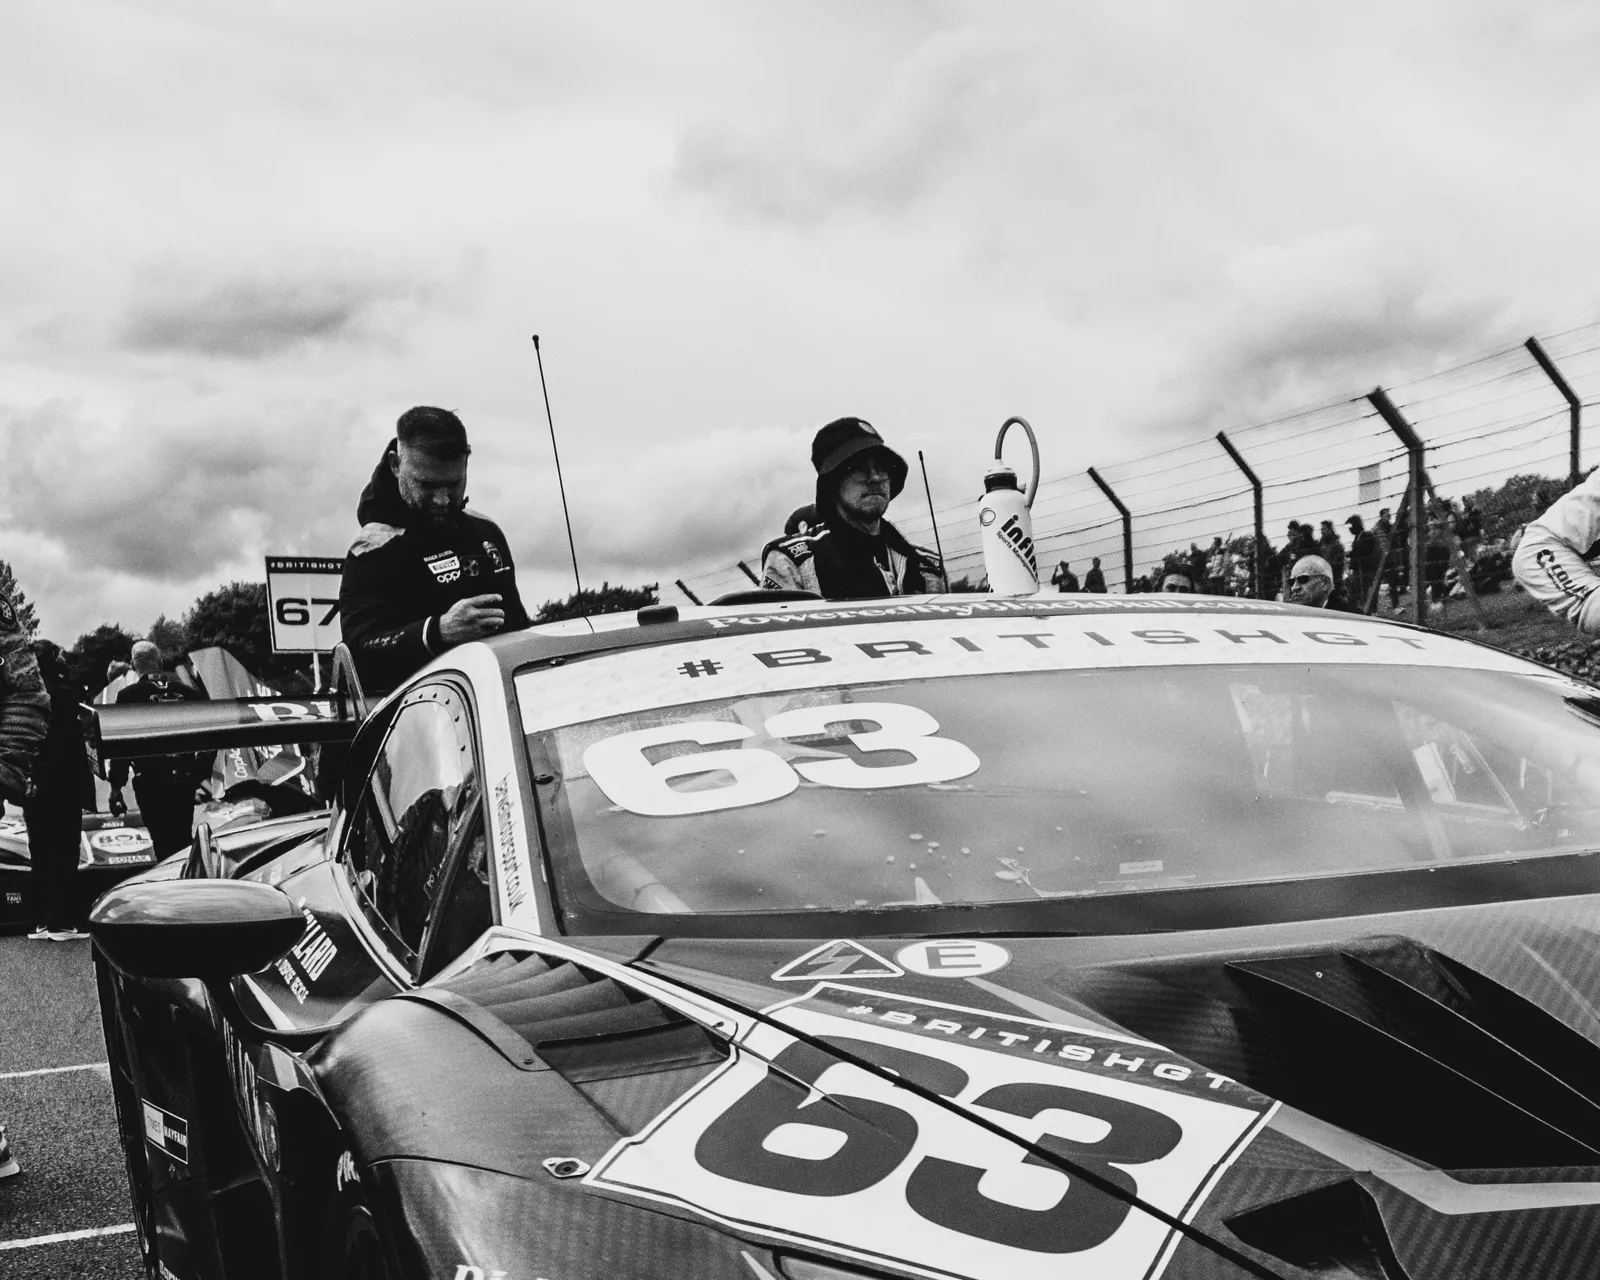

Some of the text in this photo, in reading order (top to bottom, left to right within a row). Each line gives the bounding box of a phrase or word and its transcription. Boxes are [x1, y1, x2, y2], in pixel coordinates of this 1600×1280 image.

[276, 598, 341, 626] 67
[678, 628, 1428, 678] #BRITISHGT
[582, 701, 981, 816] 63
[925, 945, 982, 970] E
[847, 1004, 1238, 1090] #BRITISHGT
[694, 1034, 1182, 1254] 63
